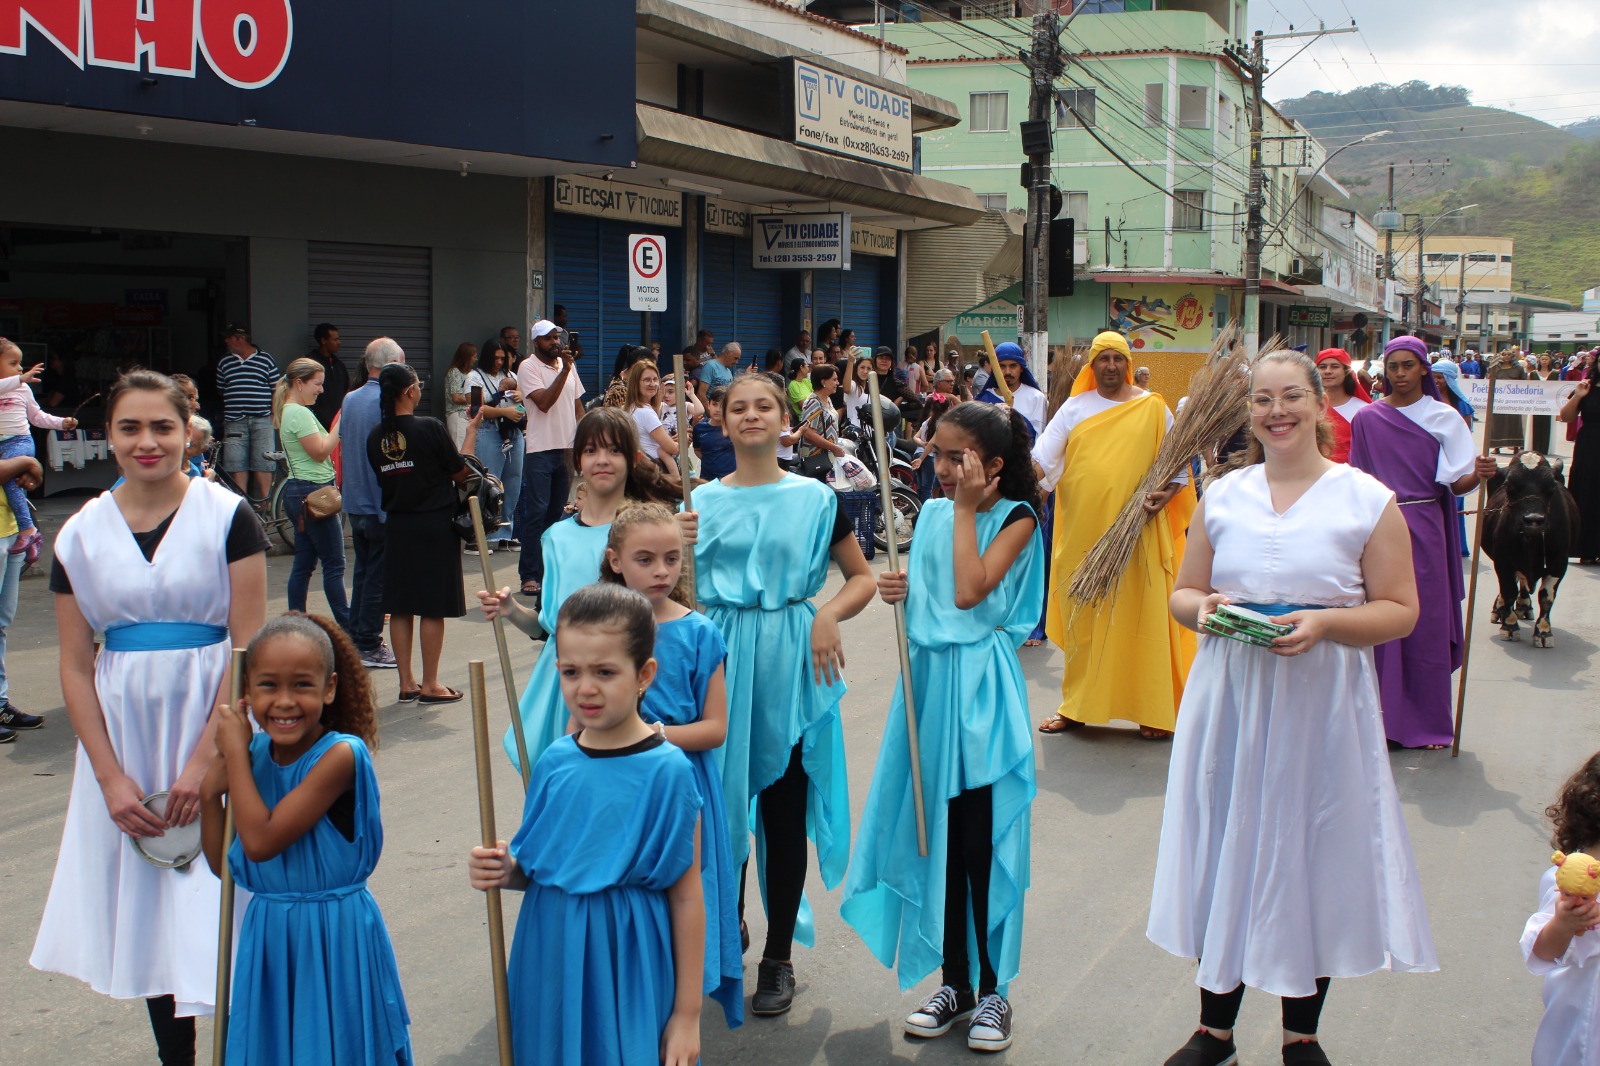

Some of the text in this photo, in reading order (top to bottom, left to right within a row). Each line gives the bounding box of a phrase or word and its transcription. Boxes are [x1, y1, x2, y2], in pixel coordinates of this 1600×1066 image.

[824, 74, 910, 120] TV CIDADE
[799, 125, 839, 146] Fone/fax
[575, 185, 623, 210] TECSAT
[639, 196, 651, 214] TV
[651, 198, 679, 217] CIDADE
[720, 208, 751, 230] TECSA
[784, 223, 798, 239] TV
[800, 222, 839, 239] CIDADE
[877, 235, 895, 250] CIDADE
[643, 247, 653, 269] E
[758, 253, 837, 263] Tel: (28) 3553-2597
[637, 286, 660, 294] MOTOS
[959, 316, 1018, 327] MARCEL
[1472, 383, 1544, 395] Poétos/Sabedoria
